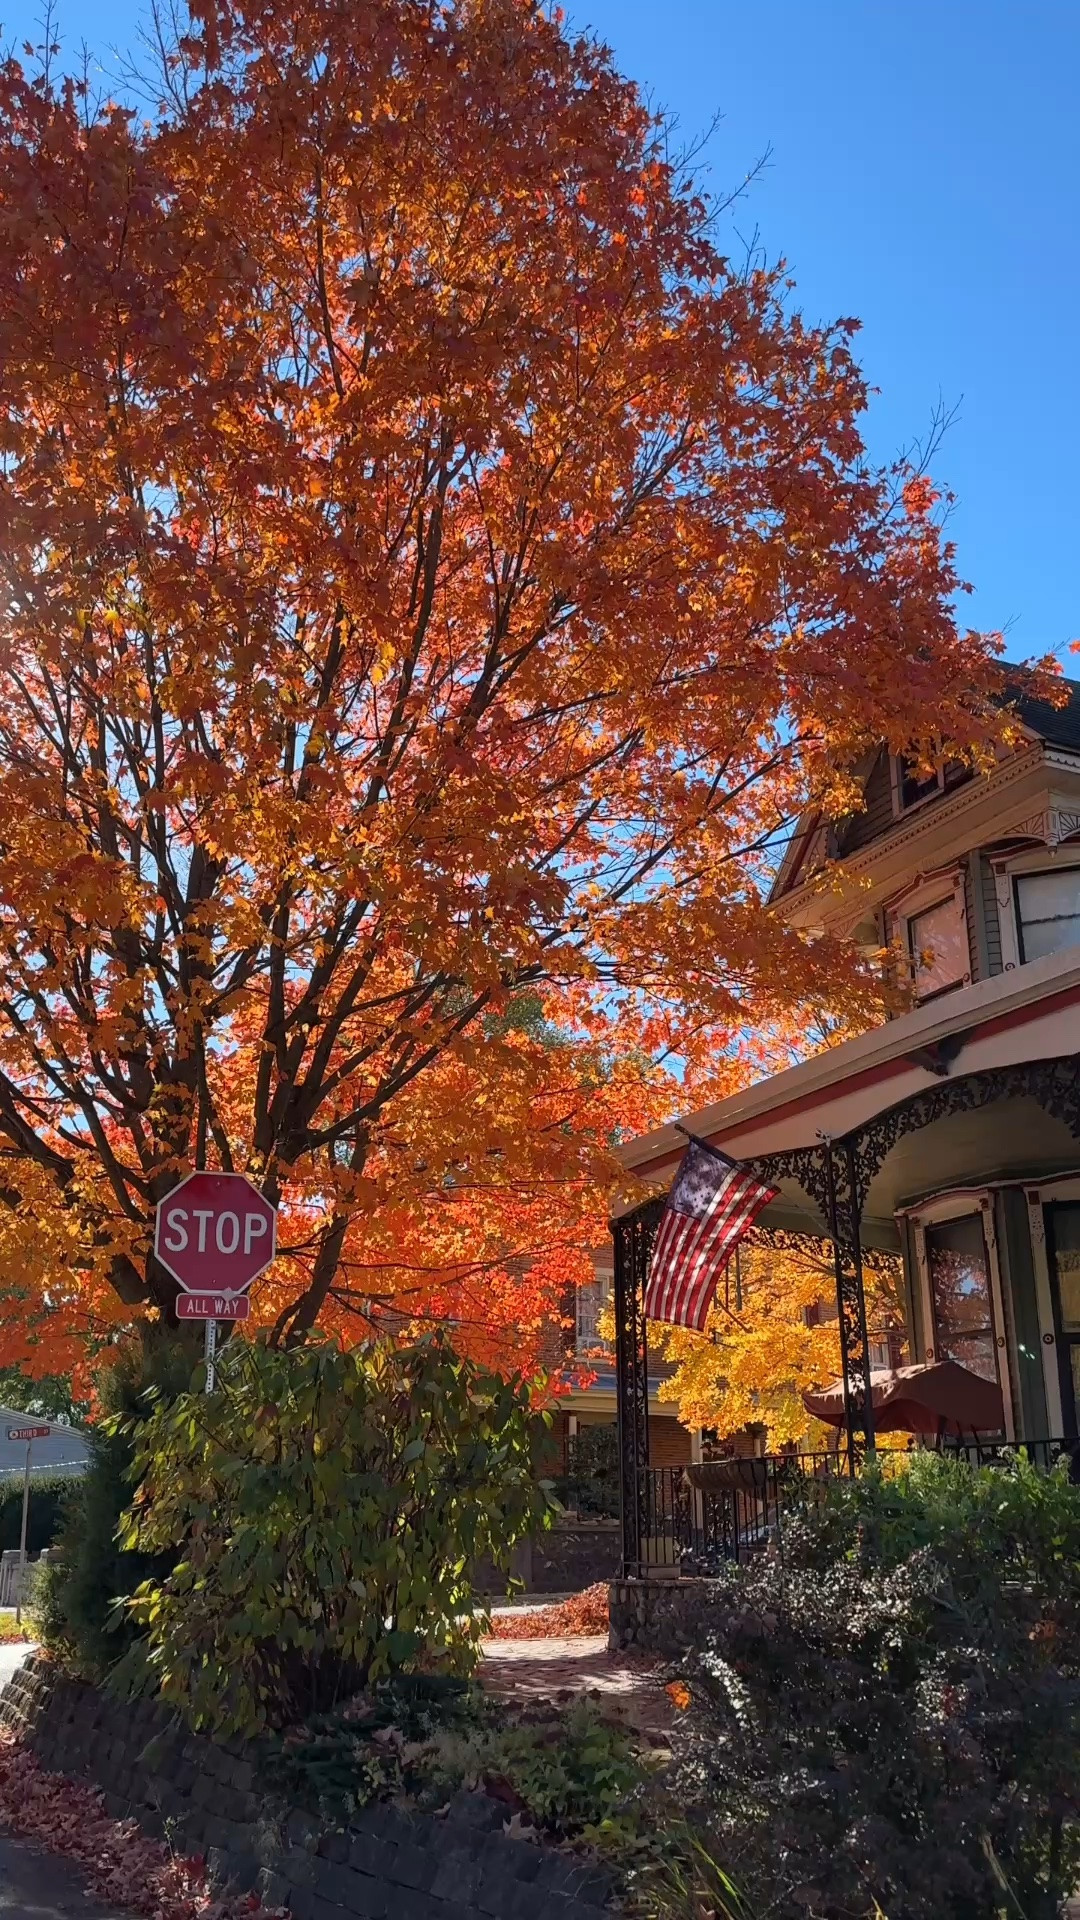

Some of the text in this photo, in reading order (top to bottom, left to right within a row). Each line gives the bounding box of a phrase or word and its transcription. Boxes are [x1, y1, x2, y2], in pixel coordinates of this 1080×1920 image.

[164, 1208, 268, 1254] STOP
[187, 1299, 239, 1314] ALL WAY
[19, 1429, 37, 1438] THIRD
